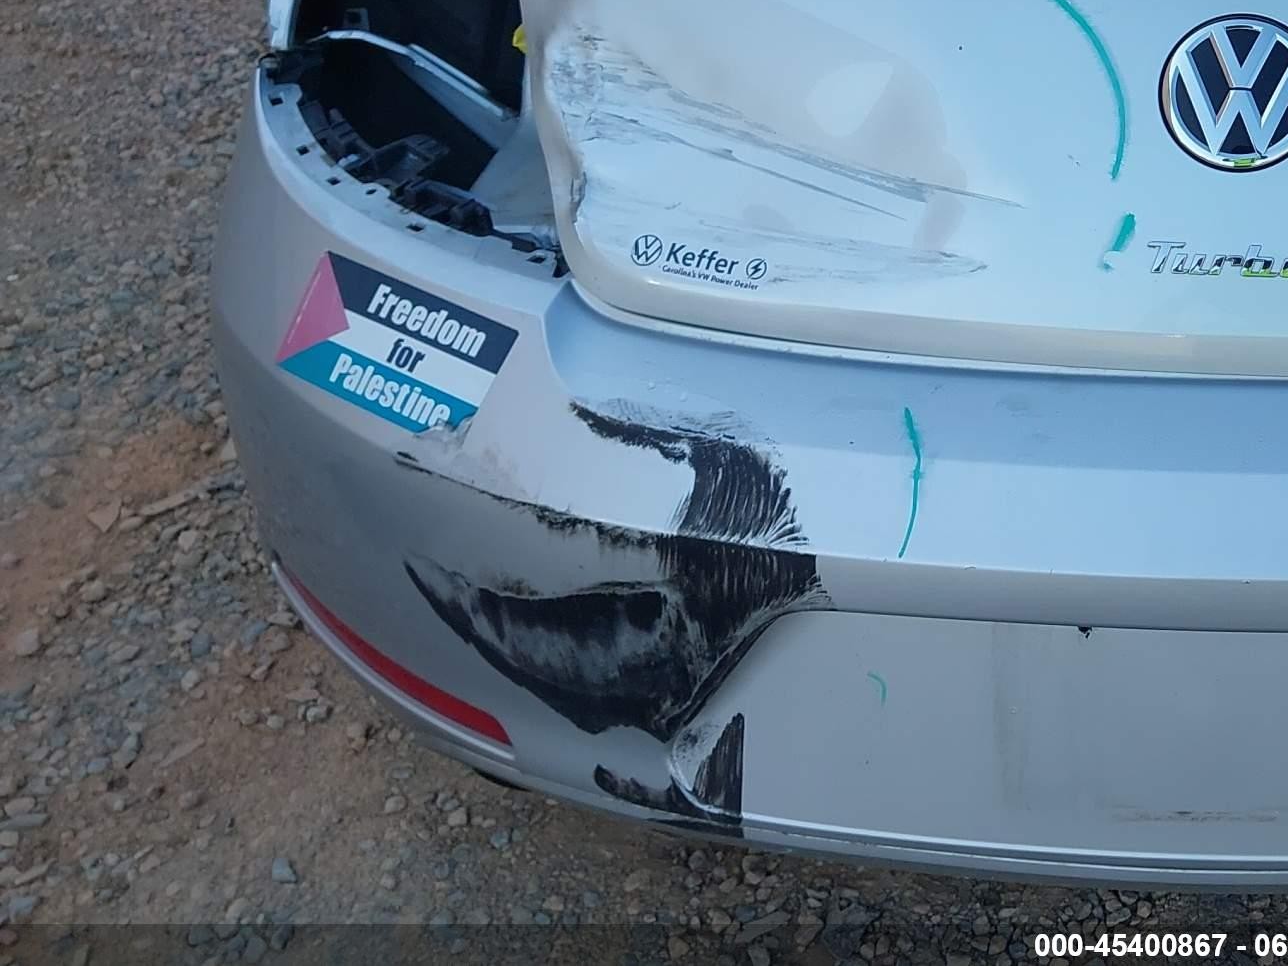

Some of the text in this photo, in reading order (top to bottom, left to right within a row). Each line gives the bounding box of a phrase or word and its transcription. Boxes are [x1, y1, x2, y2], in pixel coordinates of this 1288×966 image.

[666, 243, 739, 275] Keffer
[711, 275, 733, 286] Power
[735, 279, 759, 291] Dealer
[366, 283, 486, 358] Freedom
[386, 338, 426, 373] for
[329, 353, 452, 431] Palestine
